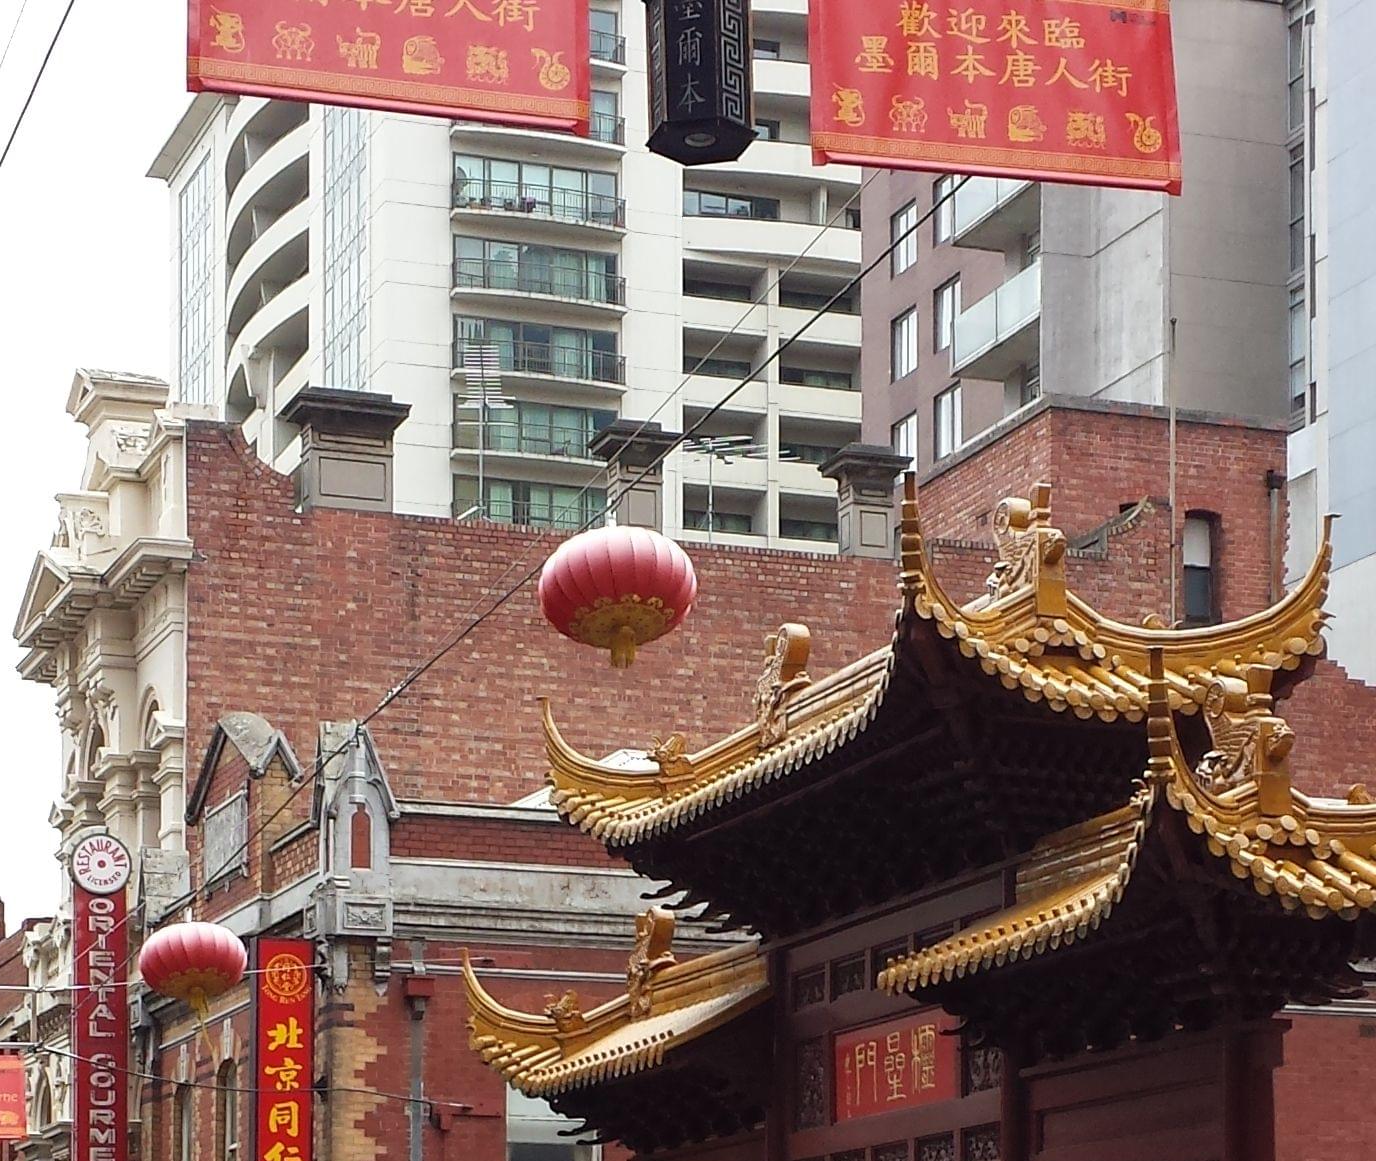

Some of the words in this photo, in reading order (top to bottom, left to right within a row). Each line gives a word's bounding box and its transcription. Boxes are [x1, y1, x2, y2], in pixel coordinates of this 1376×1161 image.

[895, 1, 1086, 49] 歡迎來臨
[854, 35, 1133, 98] 墨爾本唐人街
[76, 838, 128, 876] RESTAURANT
[86, 871, 122, 886] LICENSED
[87, 898, 116, 1039] ORIENTAL
